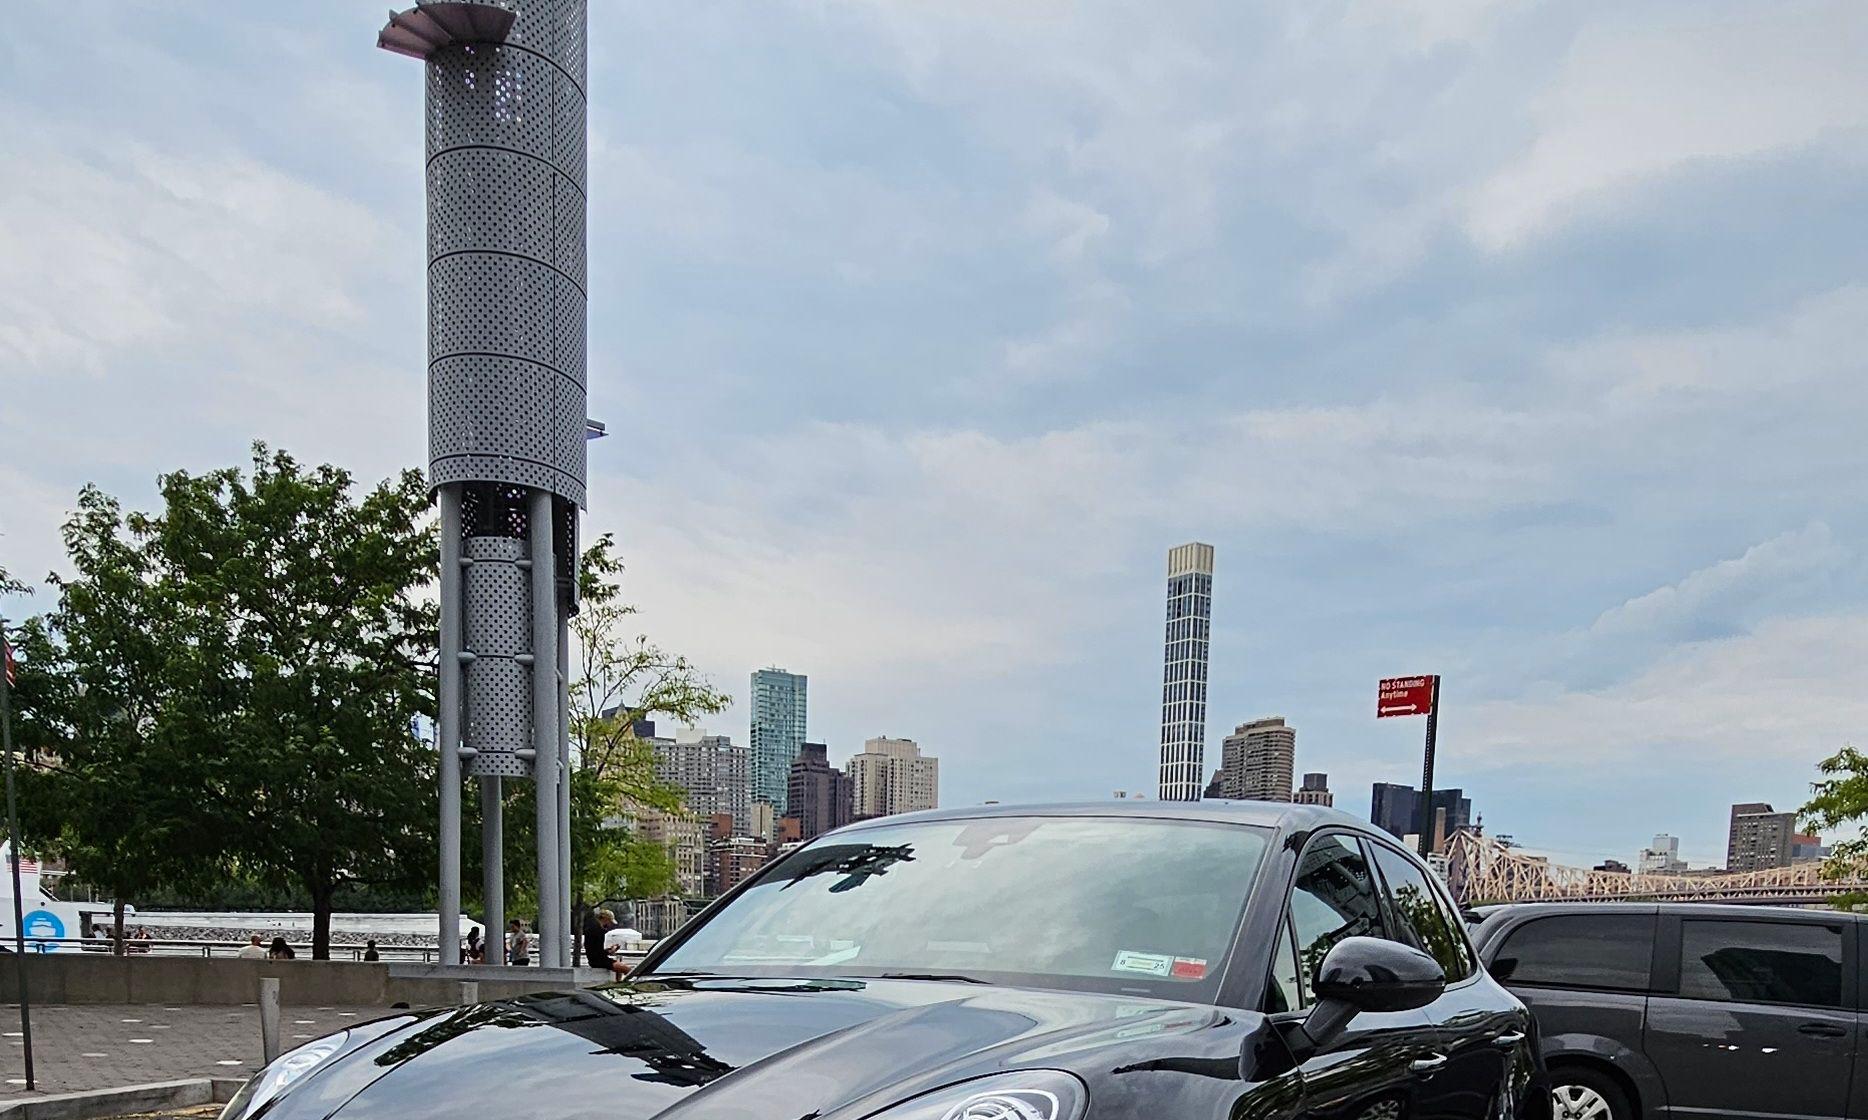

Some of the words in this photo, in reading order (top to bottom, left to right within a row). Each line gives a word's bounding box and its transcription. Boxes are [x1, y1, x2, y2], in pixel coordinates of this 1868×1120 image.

[1381, 682, 1391, 690] NO
[1391, 679, 1425, 689] STANDING
[1381, 690, 1408, 700] Anytime
